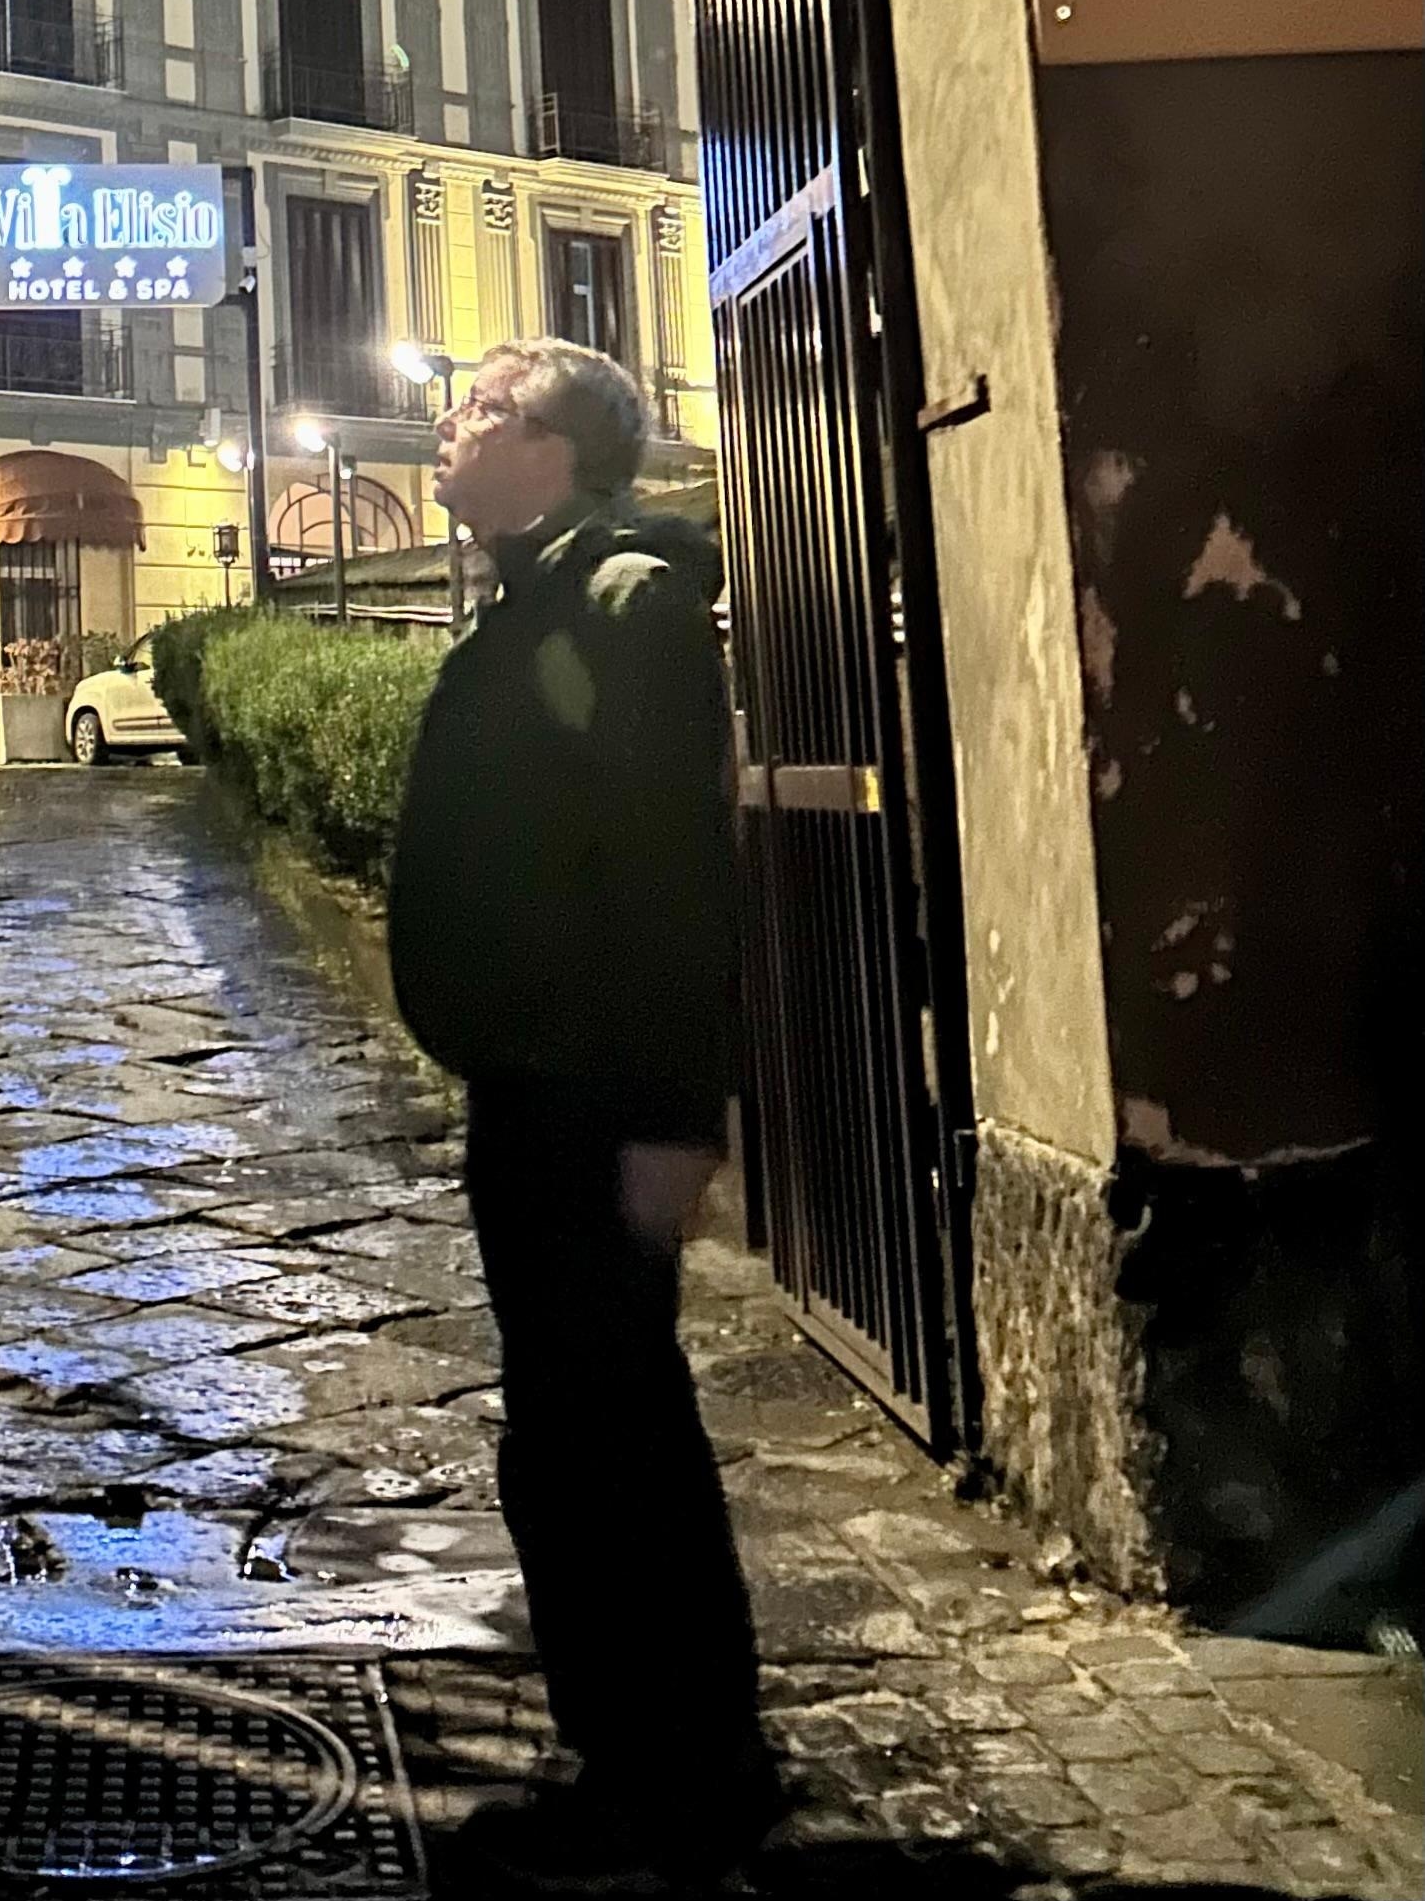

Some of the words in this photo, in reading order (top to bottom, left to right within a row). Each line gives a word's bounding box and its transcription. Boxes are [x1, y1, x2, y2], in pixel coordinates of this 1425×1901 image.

[92, 186, 221, 250] Elisio
[7, 279, 101, 301] HOTEL
[107, 280, 129, 301] &
[135, 279, 191, 300] SPA
